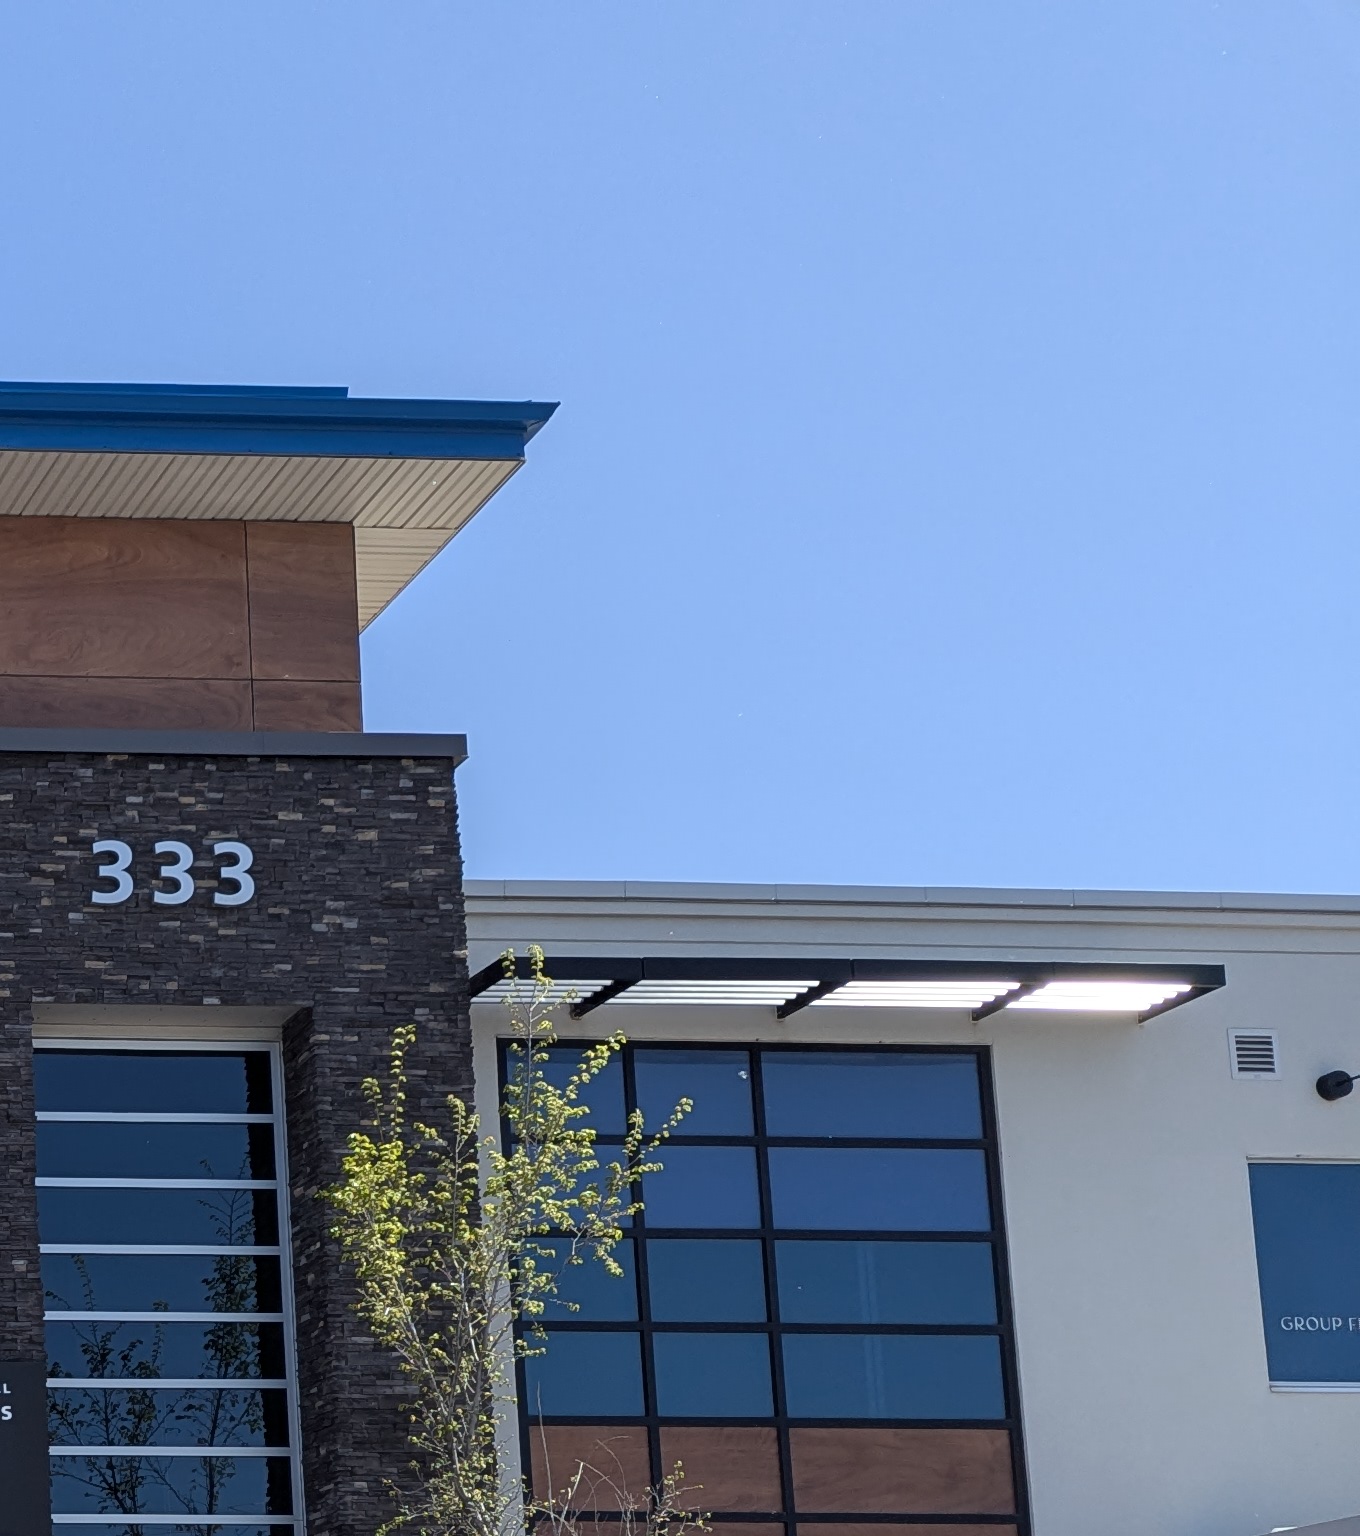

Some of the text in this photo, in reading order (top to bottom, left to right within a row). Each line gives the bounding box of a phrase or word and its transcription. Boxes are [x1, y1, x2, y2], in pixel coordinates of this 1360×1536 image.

[91, 839, 256, 906] 333
[1280, 1316, 1360, 1331] GROUP F
